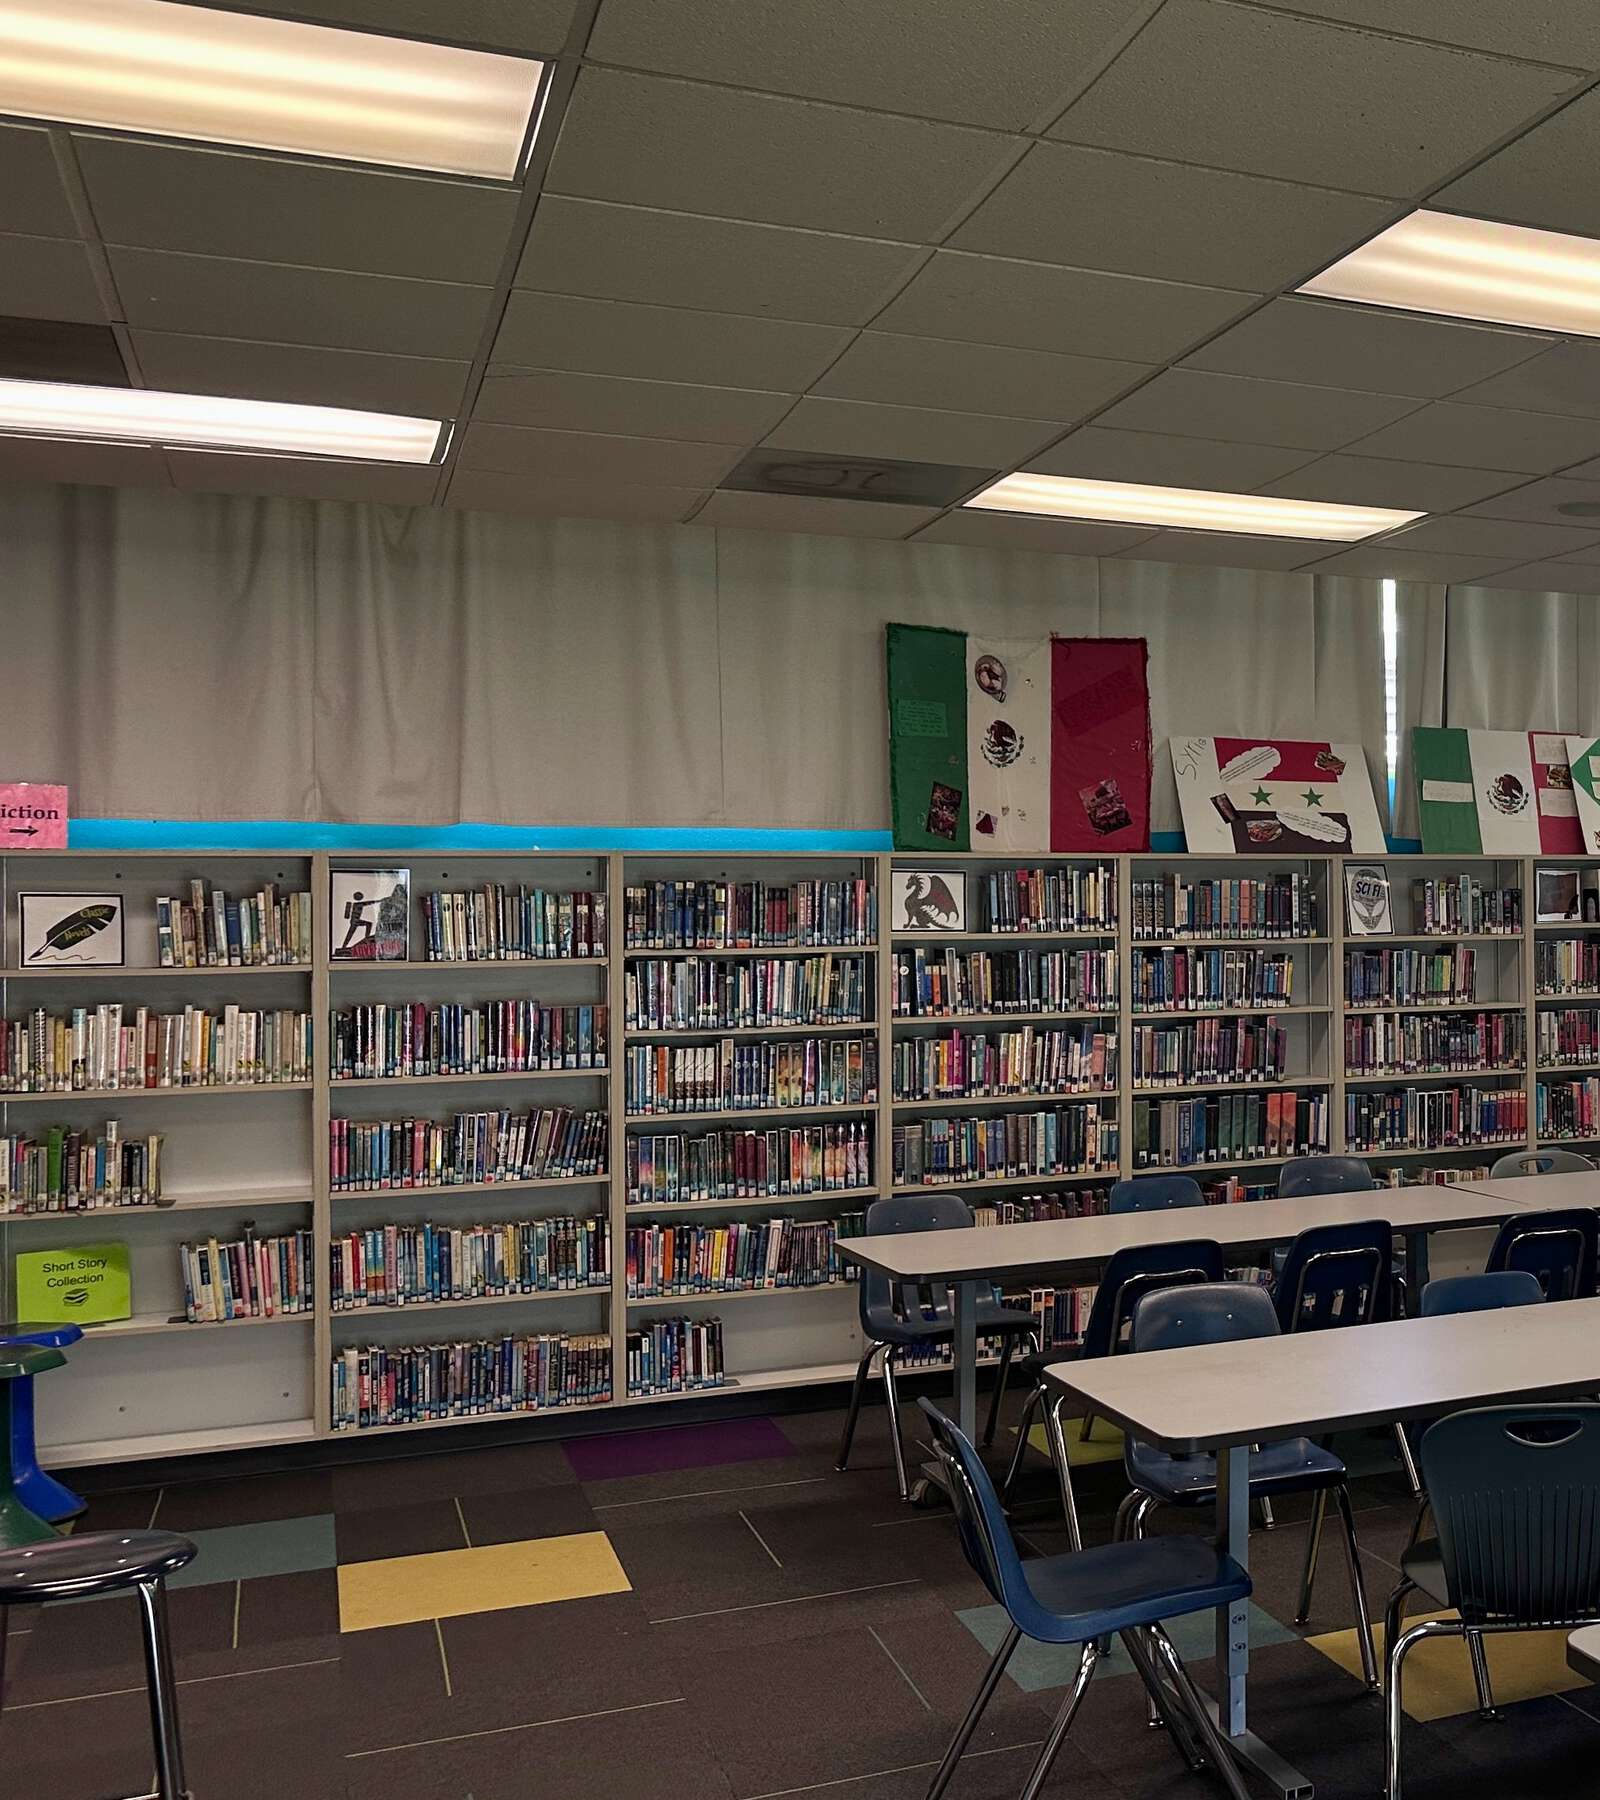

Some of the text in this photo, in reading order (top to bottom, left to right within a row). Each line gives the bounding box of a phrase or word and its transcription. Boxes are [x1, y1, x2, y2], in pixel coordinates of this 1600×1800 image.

[0, 804, 60, 820] iction
[1355, 881, 1371, 896] SCI
[42, 1258, 108, 1273] Short Story
[47, 1273, 104, 1287] Collection
